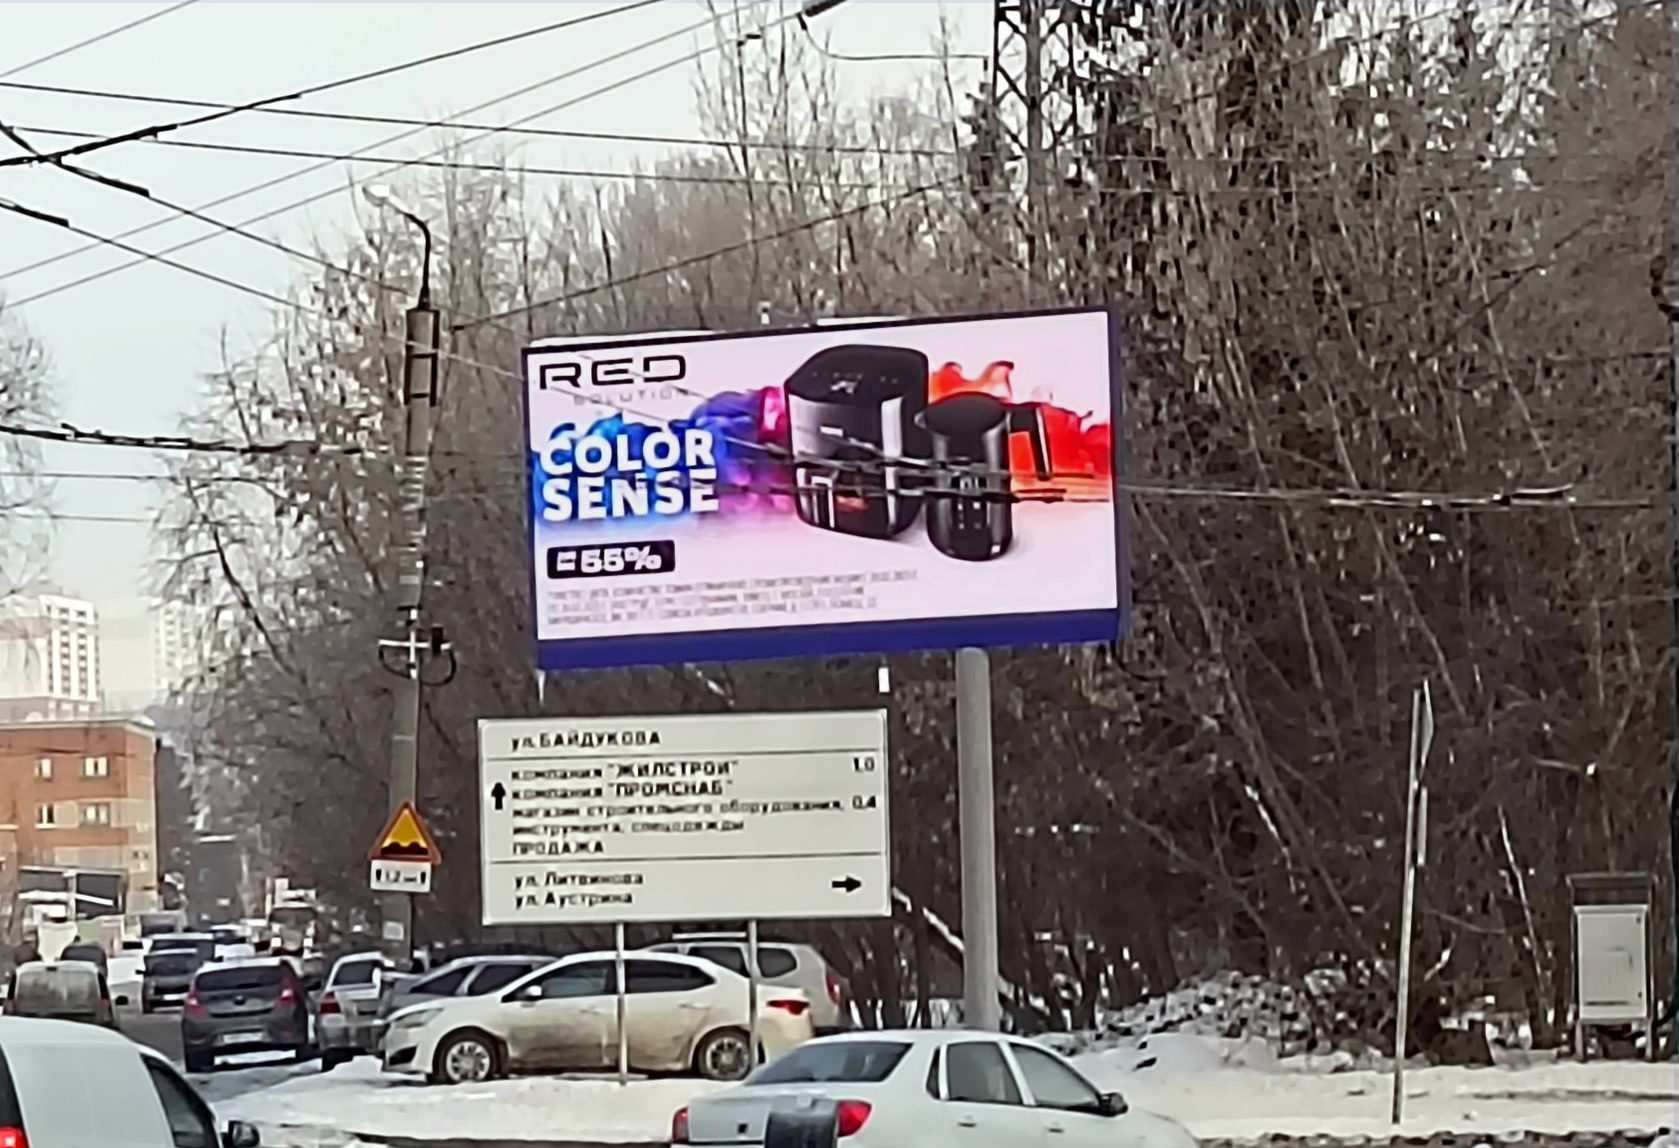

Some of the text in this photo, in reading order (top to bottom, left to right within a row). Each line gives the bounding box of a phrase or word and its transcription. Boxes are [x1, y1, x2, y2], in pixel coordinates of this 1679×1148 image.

[539, 354, 687, 390] RED
[540, 428, 716, 475] COLOR
[542, 467, 719, 522] SENSE
[539, 729, 661, 748] БАЙДУКОВА
[513, 841, 604, 855] ПРОДАЖА
